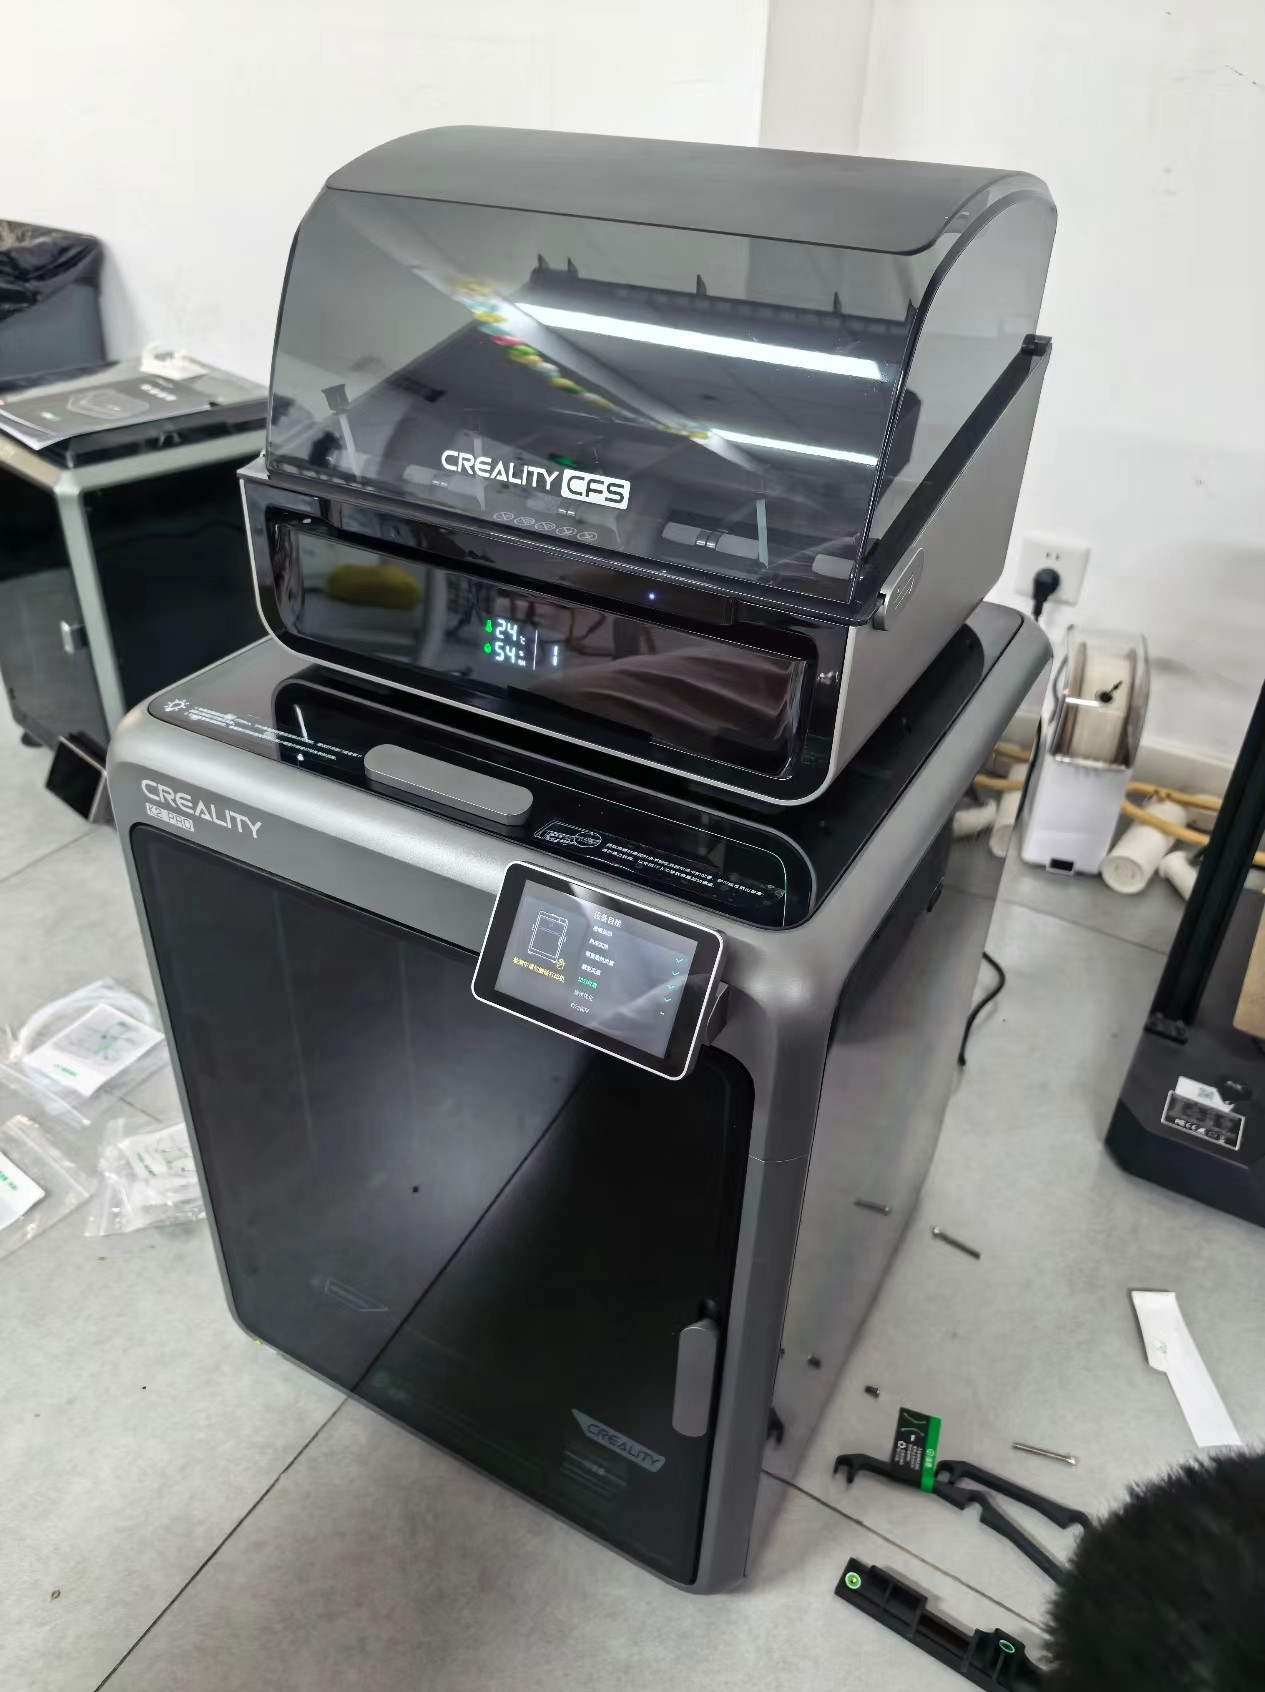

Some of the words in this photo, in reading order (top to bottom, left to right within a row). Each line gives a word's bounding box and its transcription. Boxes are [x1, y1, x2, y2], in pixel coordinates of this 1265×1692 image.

[441, 450, 559, 491] CREALITY
[564, 472, 628, 507] CFS
[141, 779, 262, 839] CREALITY
[587, 1423, 661, 1466] CREALITY
